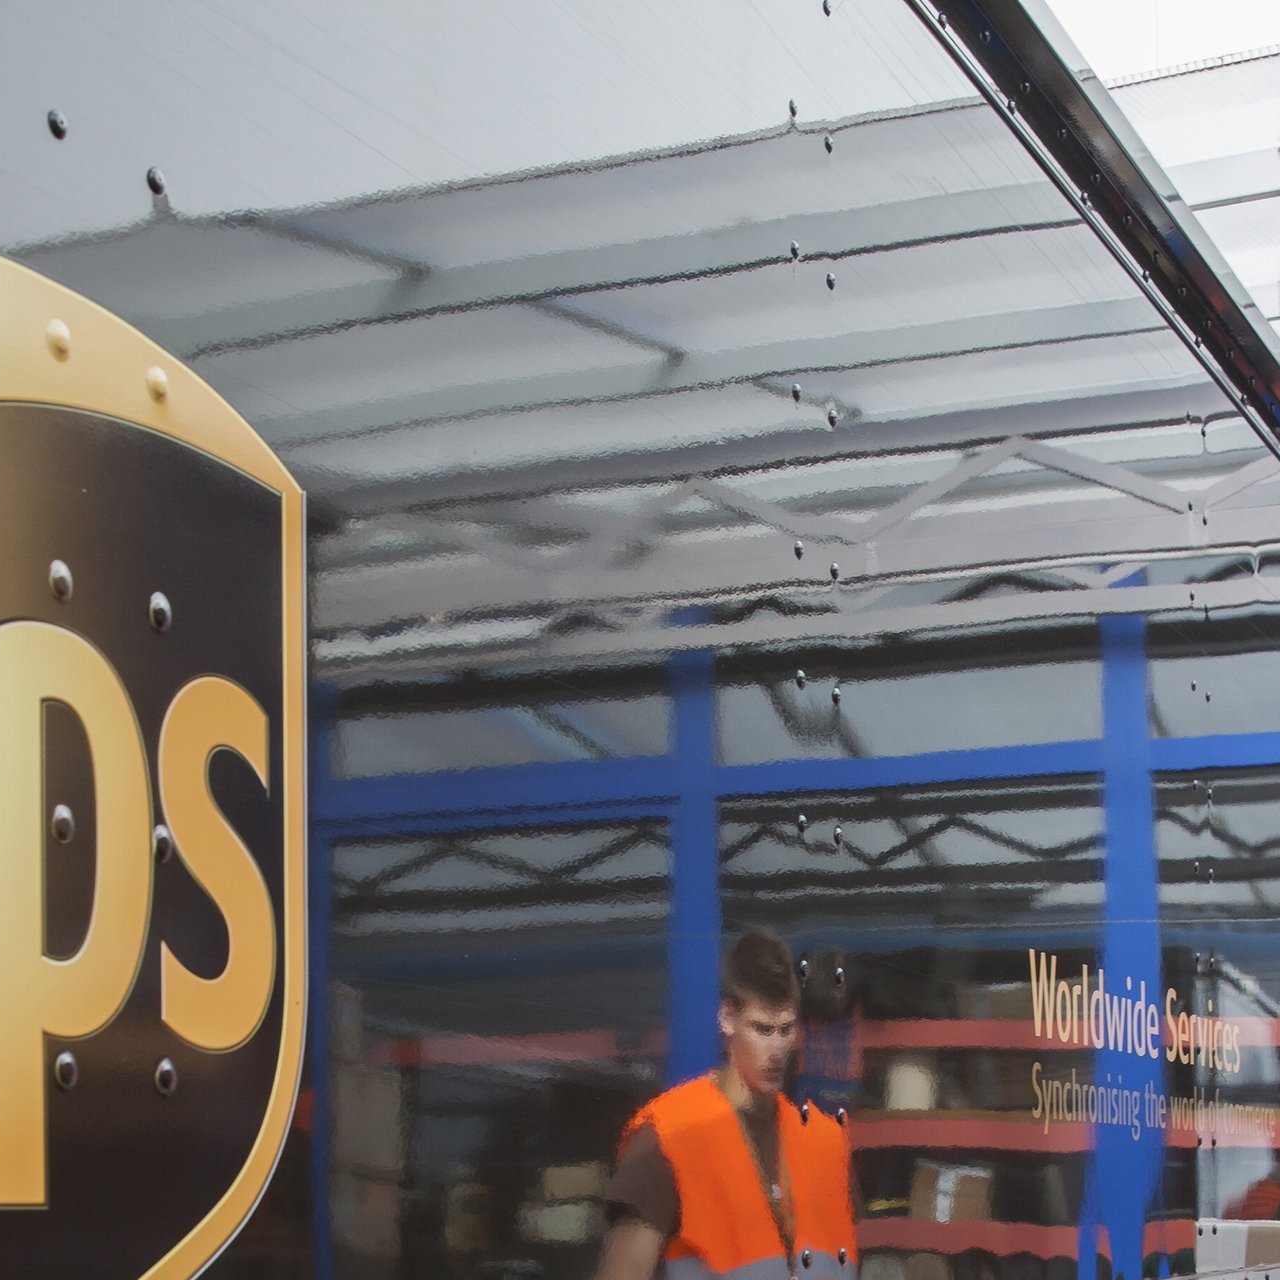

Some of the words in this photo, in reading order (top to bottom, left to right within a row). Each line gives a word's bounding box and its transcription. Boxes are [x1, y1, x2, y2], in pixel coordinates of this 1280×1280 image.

[1029, 948, 1160, 1059] Worldwide
[1165, 987, 1240, 1073] Services
[1032, 1061, 1141, 1141] Synchronising
[1144, 1079, 1167, 1129] the
[1170, 1086, 1206, 1134] world
[1208, 1088, 1221, 1133] of
[1222, 1102, 1276, 1138] commerce
